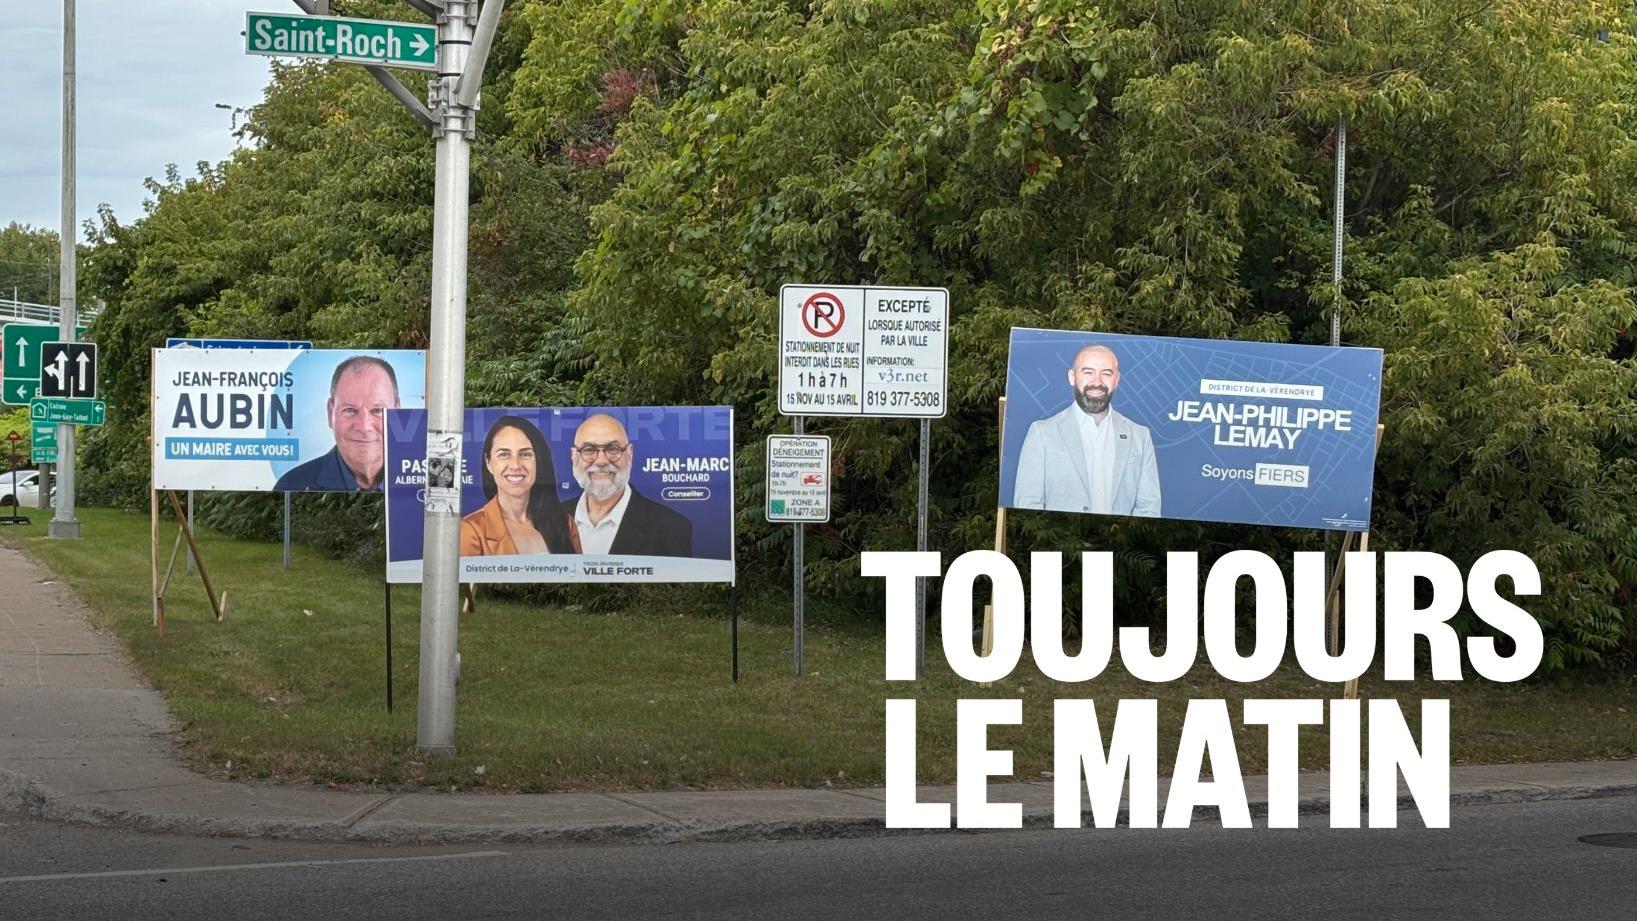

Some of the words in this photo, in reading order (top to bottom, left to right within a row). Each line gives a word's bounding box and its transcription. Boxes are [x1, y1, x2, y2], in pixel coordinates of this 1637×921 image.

[254, 18, 401, 58] Saint-Roch
[878, 296, 930, 313] EXCEPTÉ
[868, 320, 903, 331] LORSQUE
[904, 318, 942, 331] AUTORISÉ
[785, 341, 836, 353] STATIONNEMENT
[836, 342, 845, 353] DE
[846, 342, 860, 353] NUIT
[881, 335, 895, 346] PAR
[897, 336, 906, 346] LA
[908, 336, 928, 346] VILLE
[784, 356, 812, 368] INTERDIT
[813, 357, 830, 368] DANS
[830, 357, 842, 368] LES
[843, 357, 860, 369] RUES
[866, 356, 915, 366] INFORMATION:
[172, 371, 294, 392] JEAN-FRANÇOIS
[798, 372, 804, 387] 1
[808, 371, 816, 387] h
[819, 371, 826, 388] à
[829, 373, 837, 388] 7
[840, 372, 847, 388] h
[878, 368, 928, 383] v3r.net
[1208, 383, 1243, 393] DISTRICT
[786, 393, 795, 405] 15
[796, 392, 813, 405] NOV
[814, 393, 825, 405] AU
[826, 394, 835, 406] 15
[837, 393, 858, 406] AVRIL
[867, 390, 887, 406] 819
[890, 391, 940, 407] 377-5308
[172, 392, 294, 430] AUBIN
[1168, 400, 1352, 431] JEAN-PHILIPPE
[1214, 424, 1302, 450] LEMAY
[171, 442, 190, 456] UN
[192, 442, 232, 457] MAIRE
[234, 444, 260, 456] AVEC
[261, 444, 294, 457] VOUS!
[642, 457, 730, 472] JEAN-MARC
[771, 460, 821, 468] Stationnement
[662, 473, 710, 483] BOUCHARD
[1201, 464, 1254, 480] Soyons
[1258, 467, 1305, 483] FIERS
[667, 490, 704, 498] Conseiller
[465, 564, 498, 574] District
[498, 564, 508, 574] de
[510, 563, 569, 577] La-Vérendrye
[583, 567, 613, 576] VILLE
[616, 567, 654, 576] FORTE
